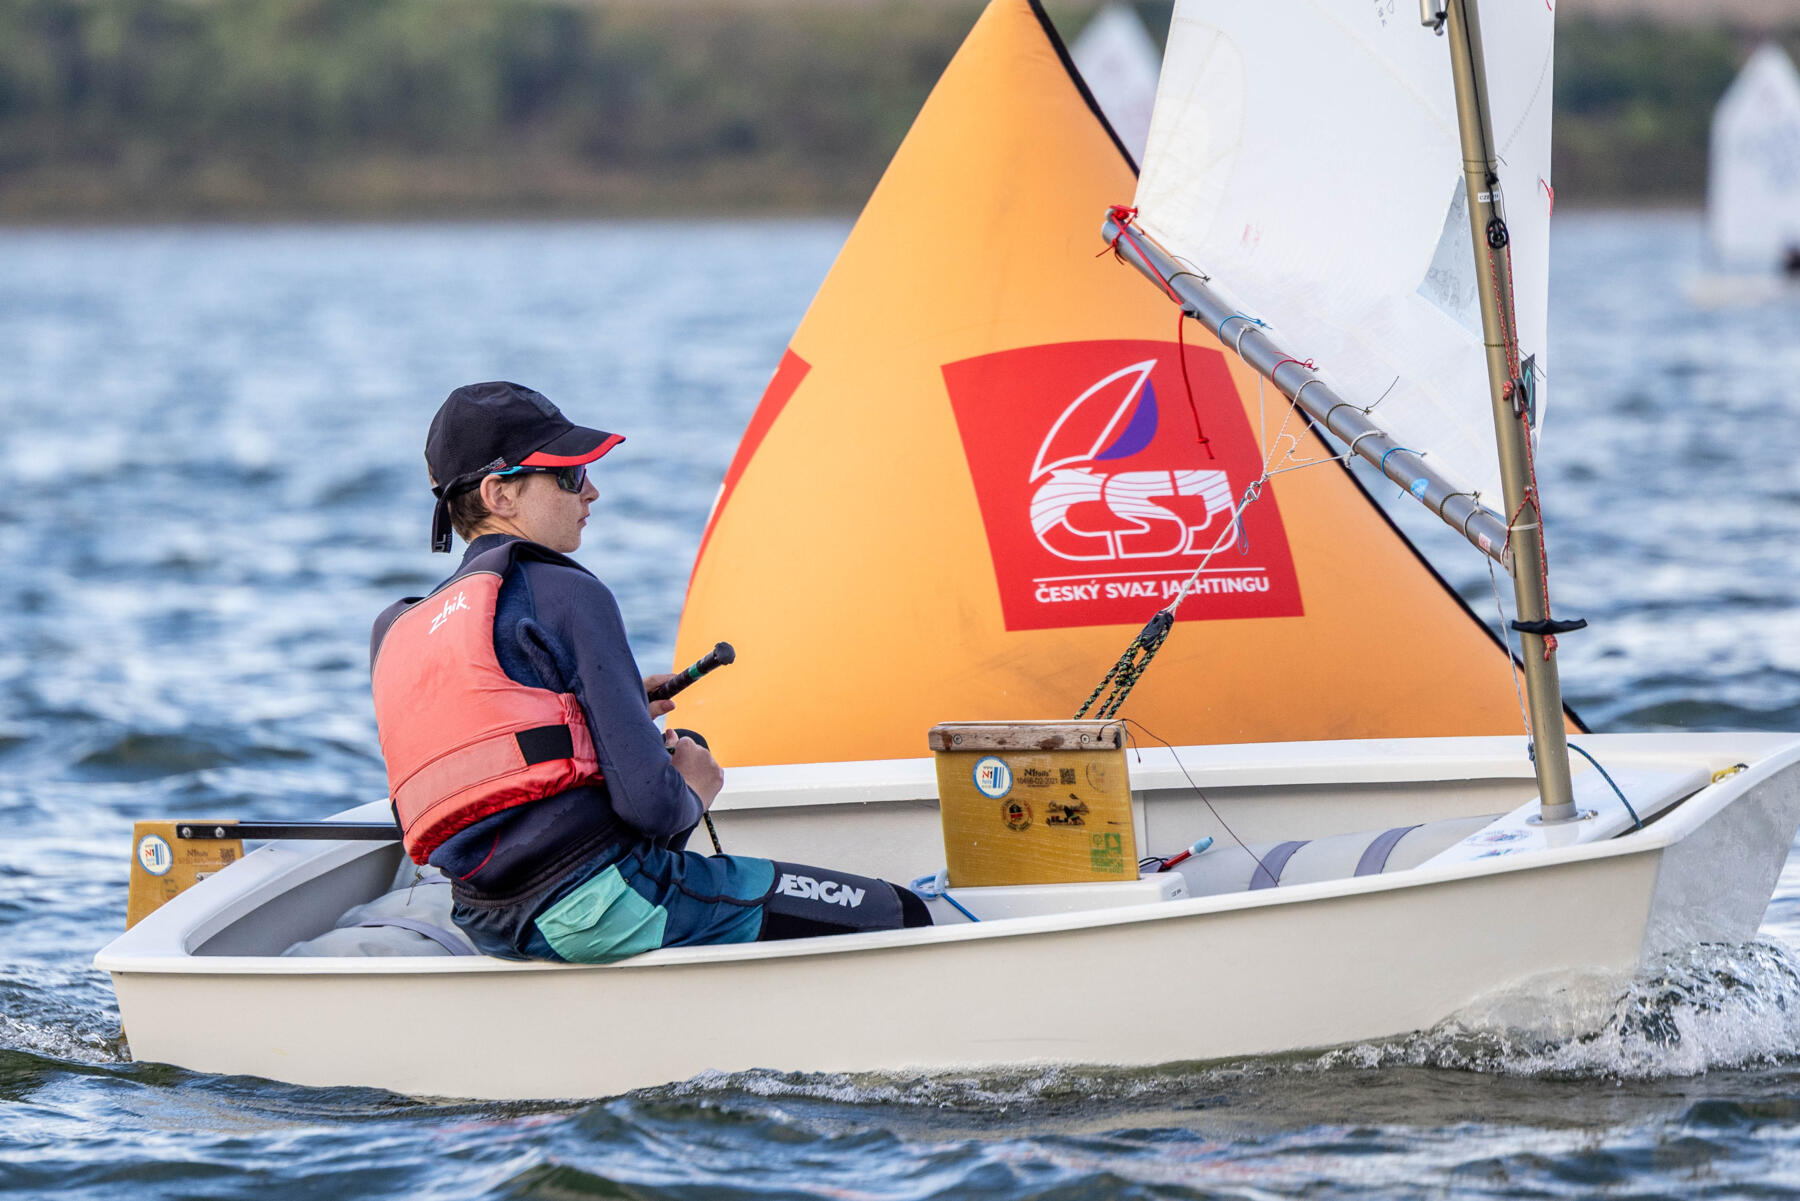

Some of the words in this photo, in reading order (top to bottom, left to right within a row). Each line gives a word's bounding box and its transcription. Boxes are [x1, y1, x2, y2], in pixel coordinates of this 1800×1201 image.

[1035, 579, 1101, 603] ČESKÝ
[1105, 581, 1159, 599] SVAZ
[1162, 577, 1270, 600] JACHTINGU
